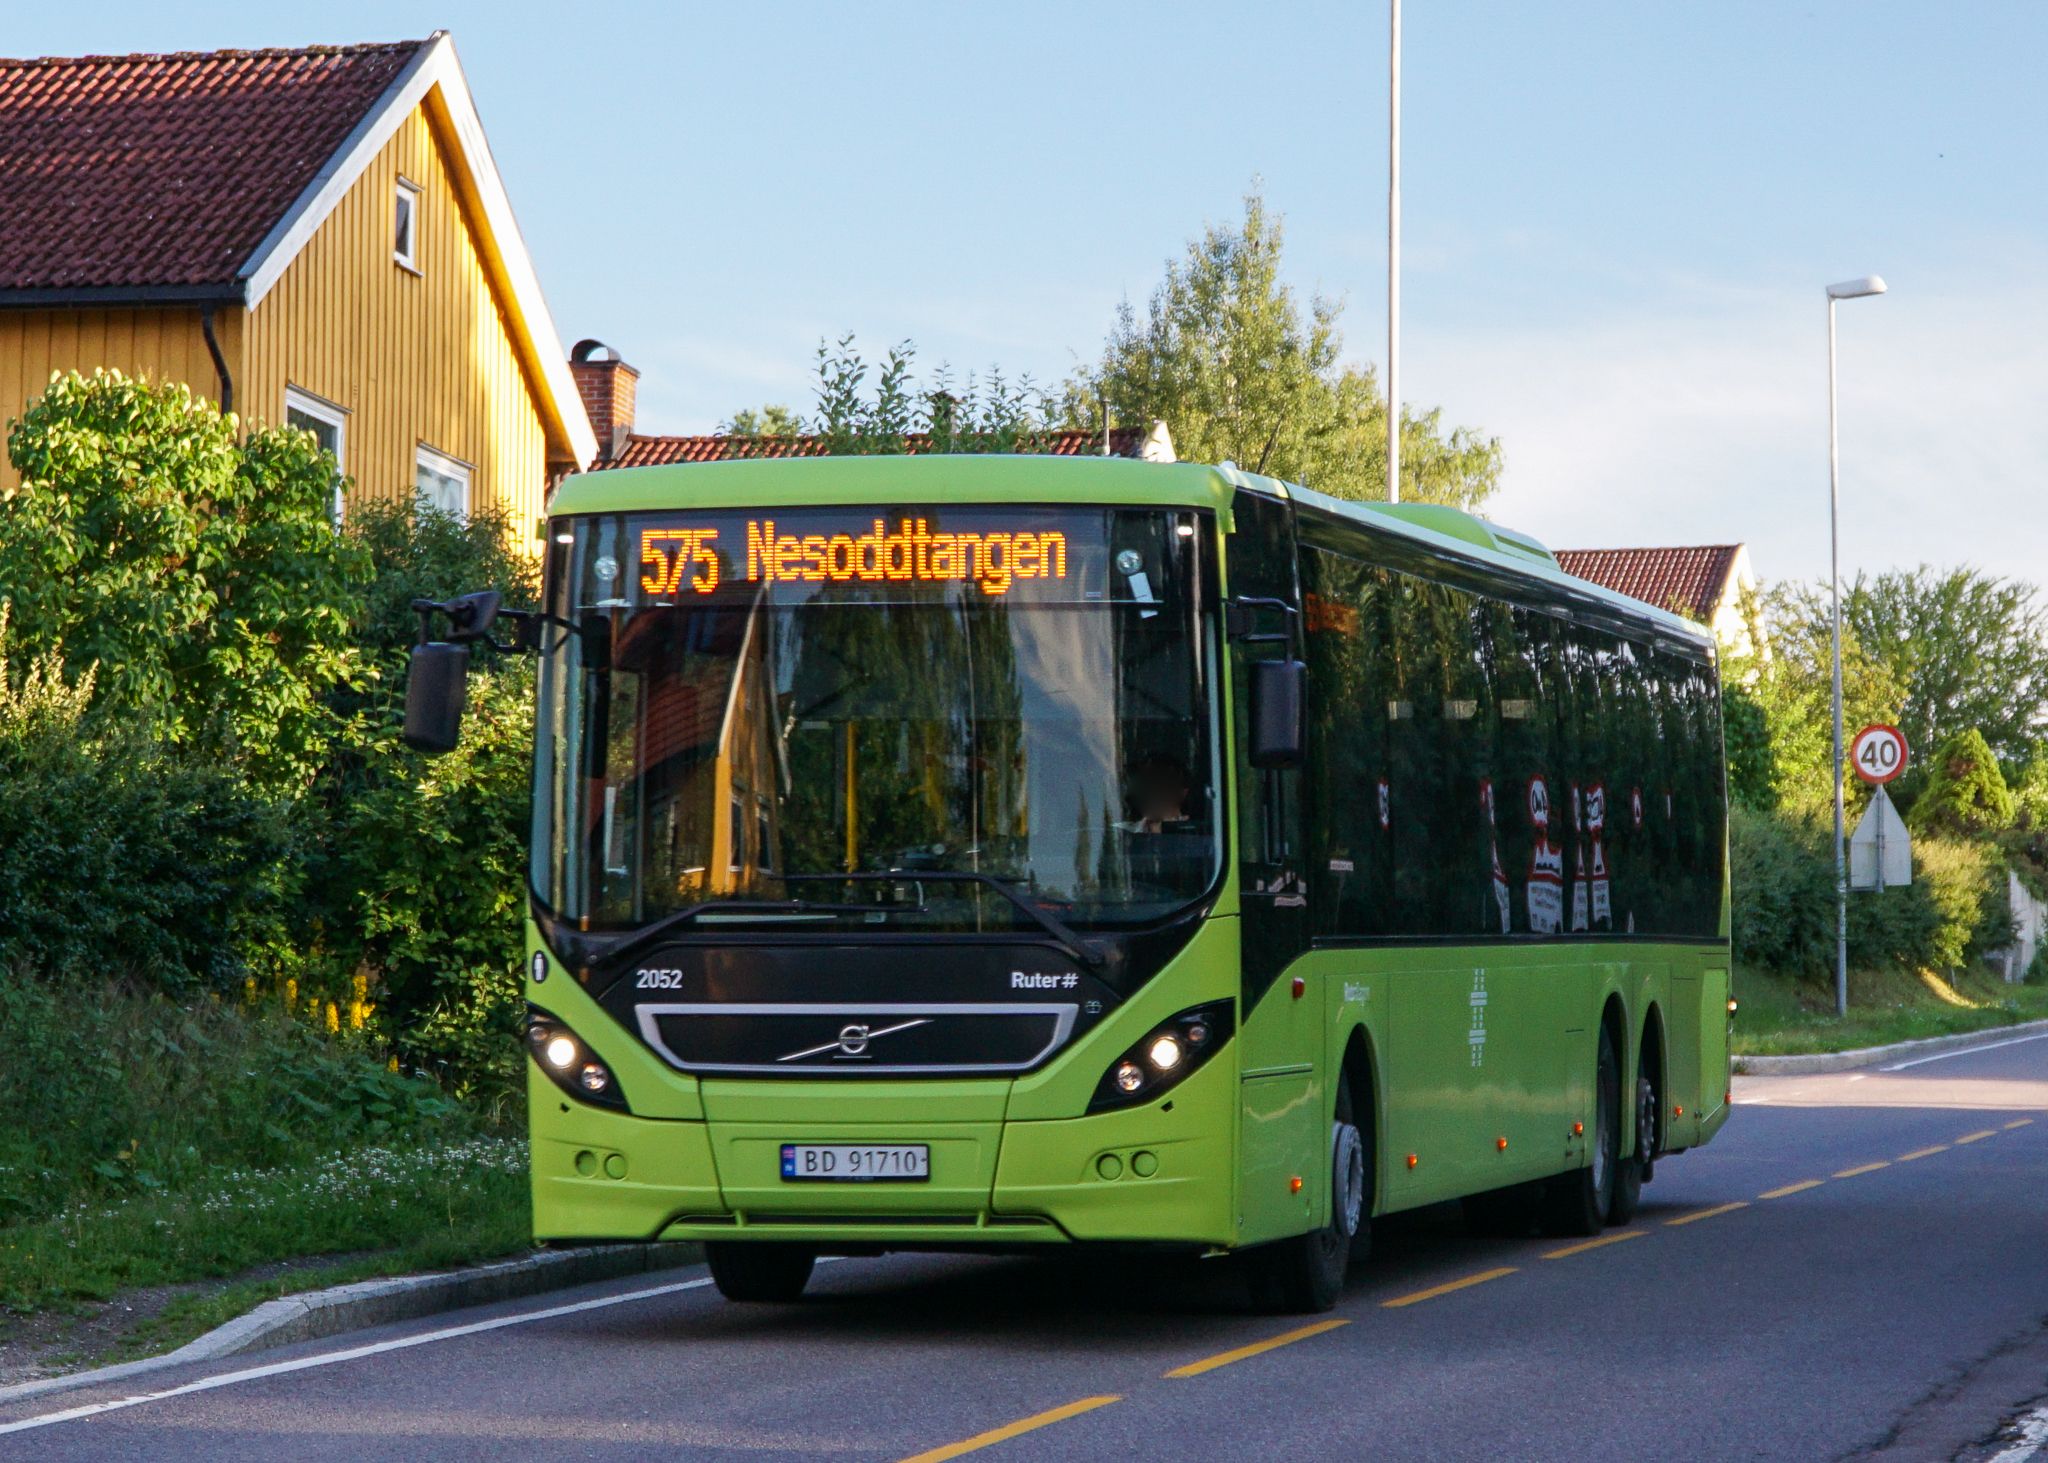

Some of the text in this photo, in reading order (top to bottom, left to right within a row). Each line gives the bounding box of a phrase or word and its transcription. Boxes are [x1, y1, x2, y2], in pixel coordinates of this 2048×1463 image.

[641, 518, 1067, 595] 575 Nesoddtangen
[1860, 739, 1898, 768] 40
[636, 969, 683, 989] 2052
[1011, 971, 1079, 989] Ruter#
[805, 1150, 917, 1174] BD 91710
